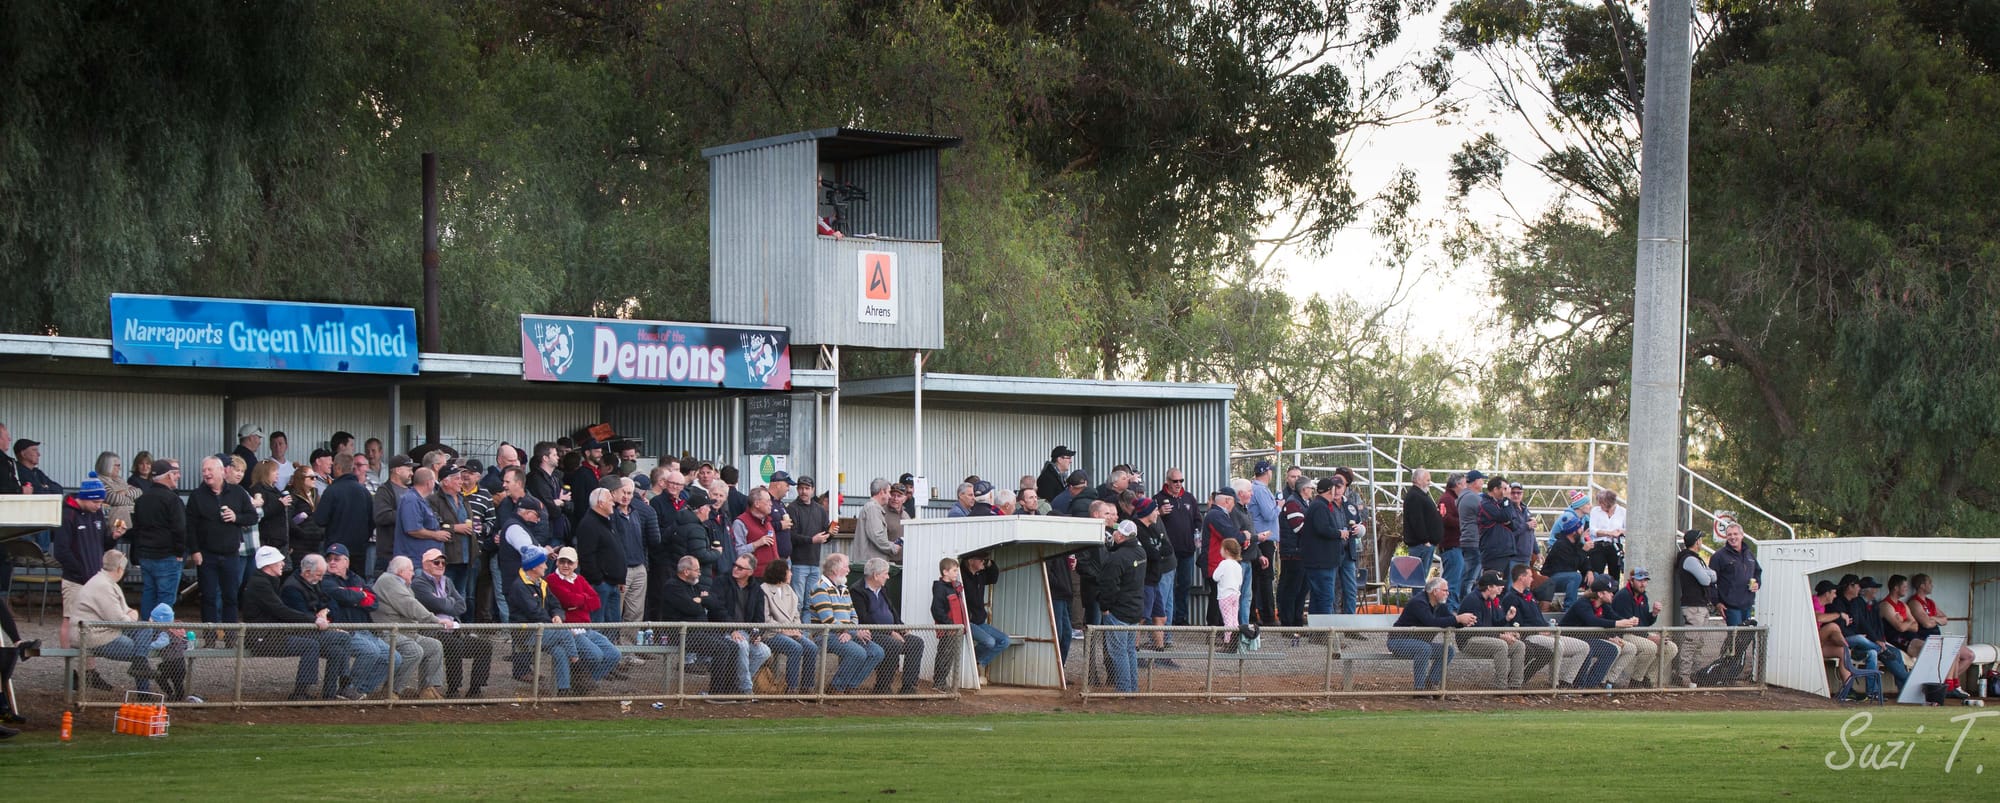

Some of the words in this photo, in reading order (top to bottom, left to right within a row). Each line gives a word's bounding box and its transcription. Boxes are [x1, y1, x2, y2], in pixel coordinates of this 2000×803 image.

[865, 304, 891, 318] Ahrens
[124, 318, 223, 349] Narraports
[228, 320, 297, 355] Green
[301, 321, 348, 356] Mill
[350, 324, 408, 358] Shed
[661, 329, 672, 342] of
[672, 330, 686, 343] the
[592, 326, 726, 381] Demons
